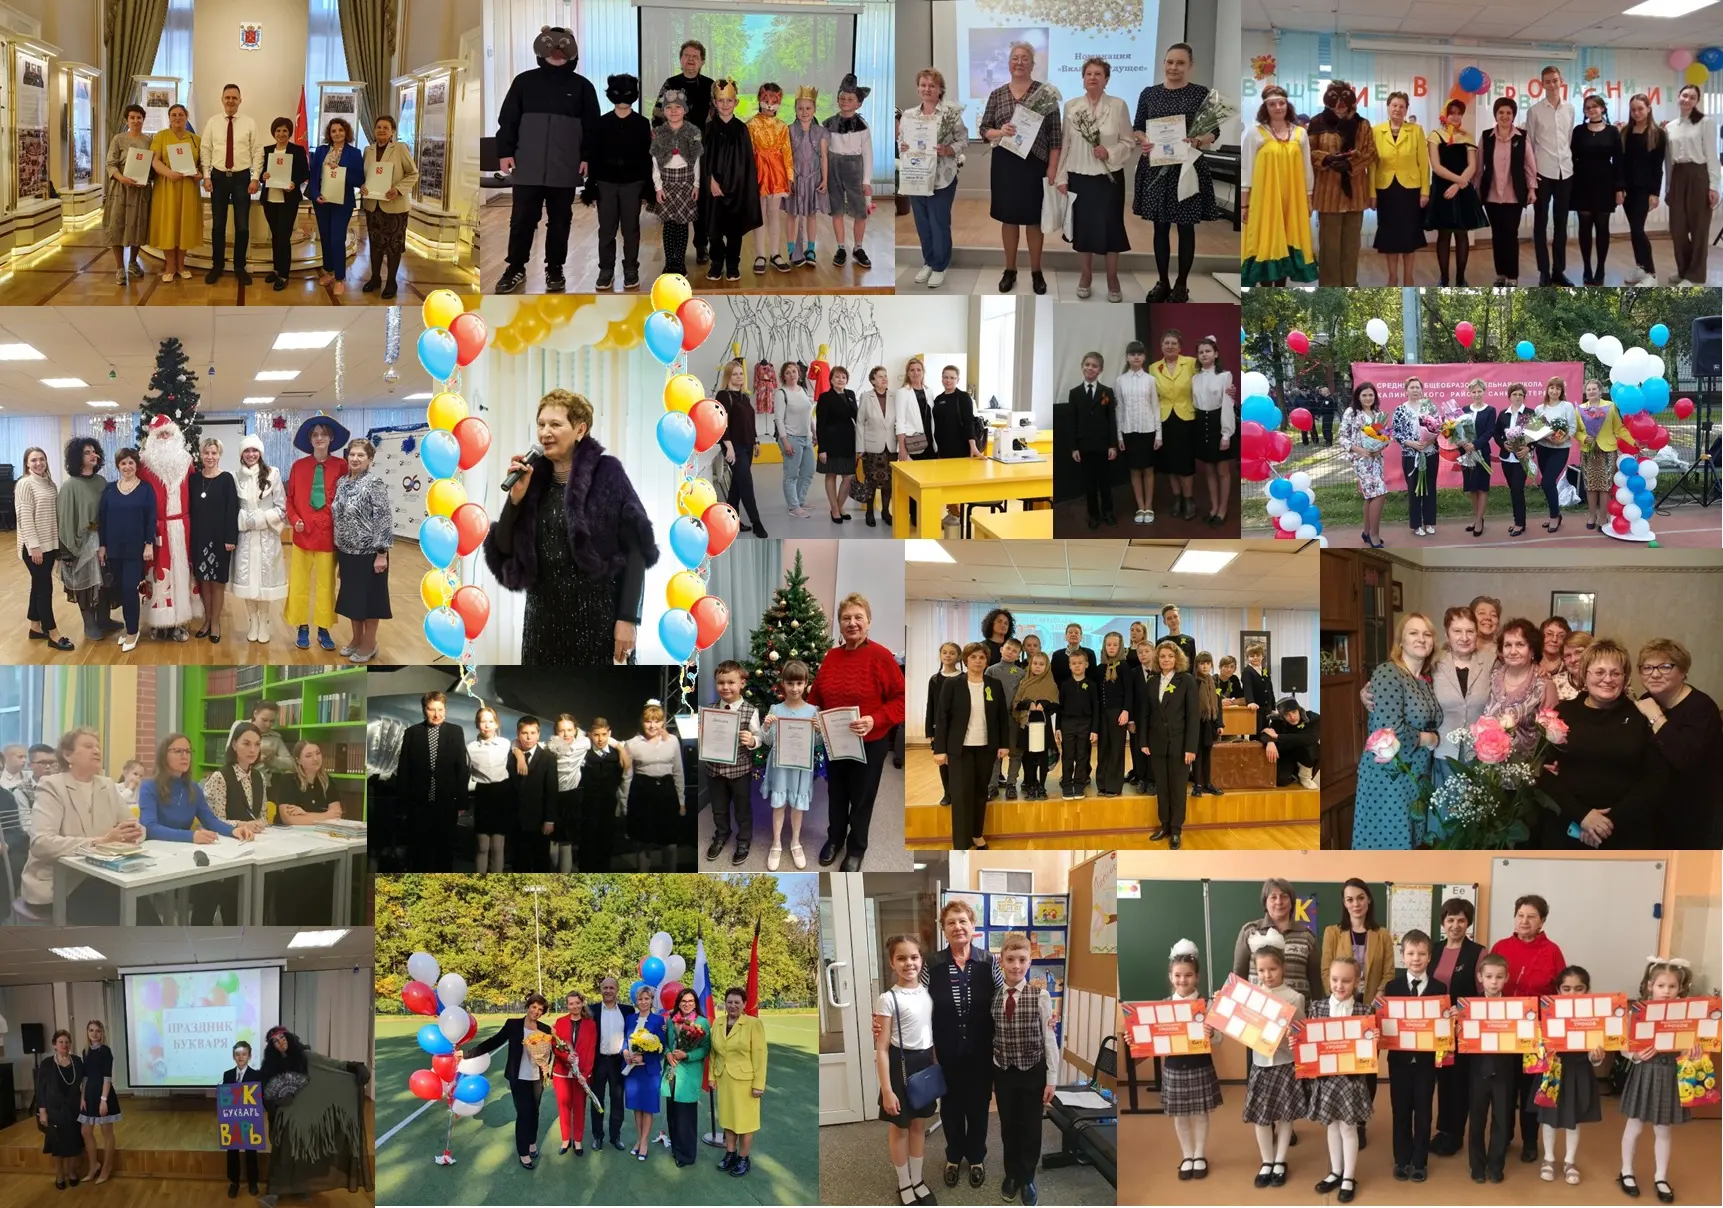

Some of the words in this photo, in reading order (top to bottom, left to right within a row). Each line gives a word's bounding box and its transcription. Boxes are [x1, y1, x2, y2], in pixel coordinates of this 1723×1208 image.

[1413, 76, 1427, 97] В
[168, 1021, 233, 1033] ПРАЗДНИК
[173, 1038, 229, 1049] БУКВАРЯ
[222, 1107, 260, 1118] БУКВАРЬ
[220, 1121, 263, 1146] ВАРЬ
